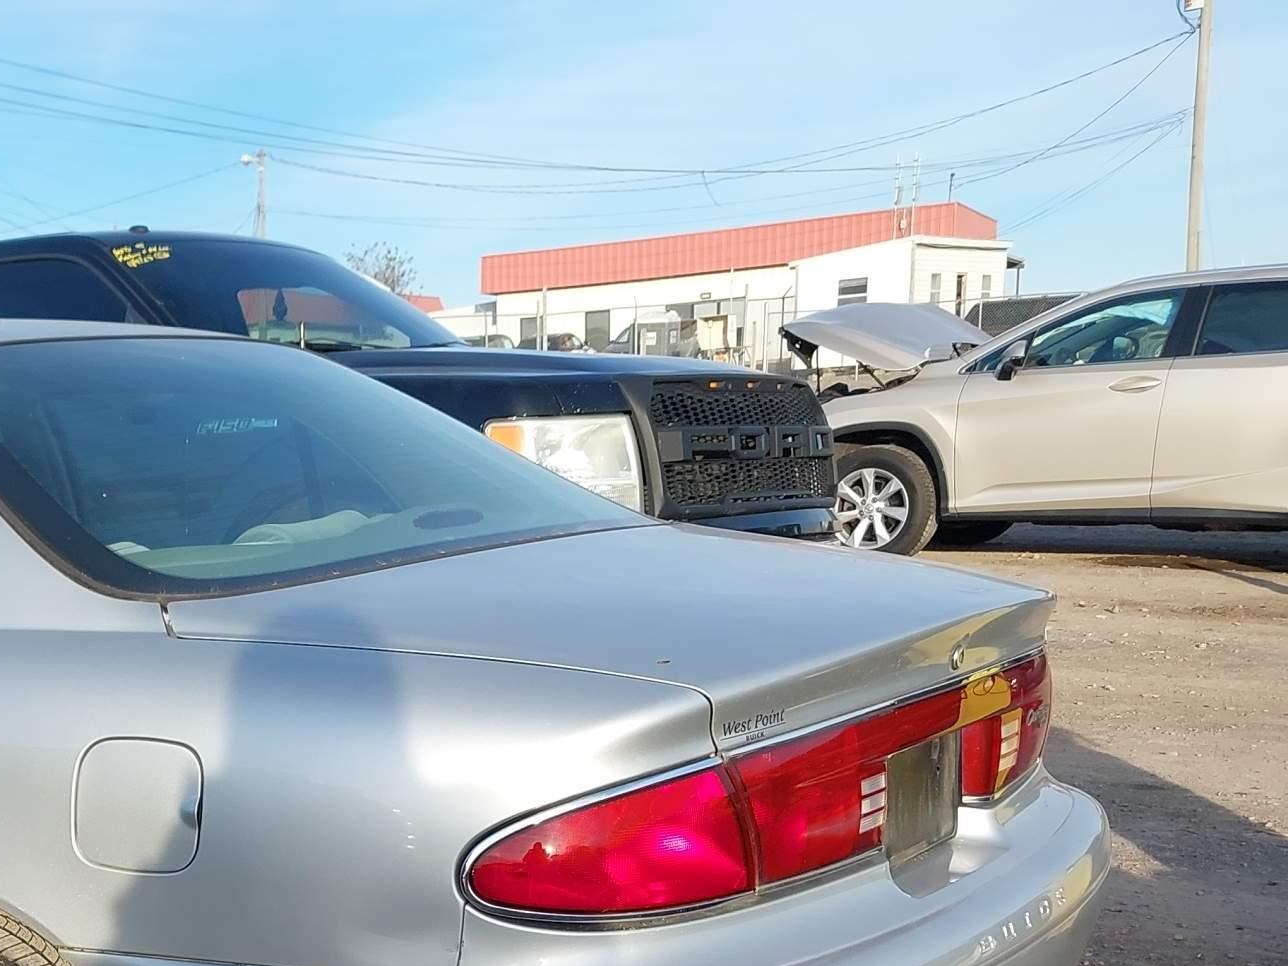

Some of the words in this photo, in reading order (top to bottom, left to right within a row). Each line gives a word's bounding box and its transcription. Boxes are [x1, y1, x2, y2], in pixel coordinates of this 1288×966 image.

[678, 426, 833, 460] FORD
[722, 718, 752, 737] West
[753, 708, 785, 729] Point
[745, 731, 765, 742] BUICK
